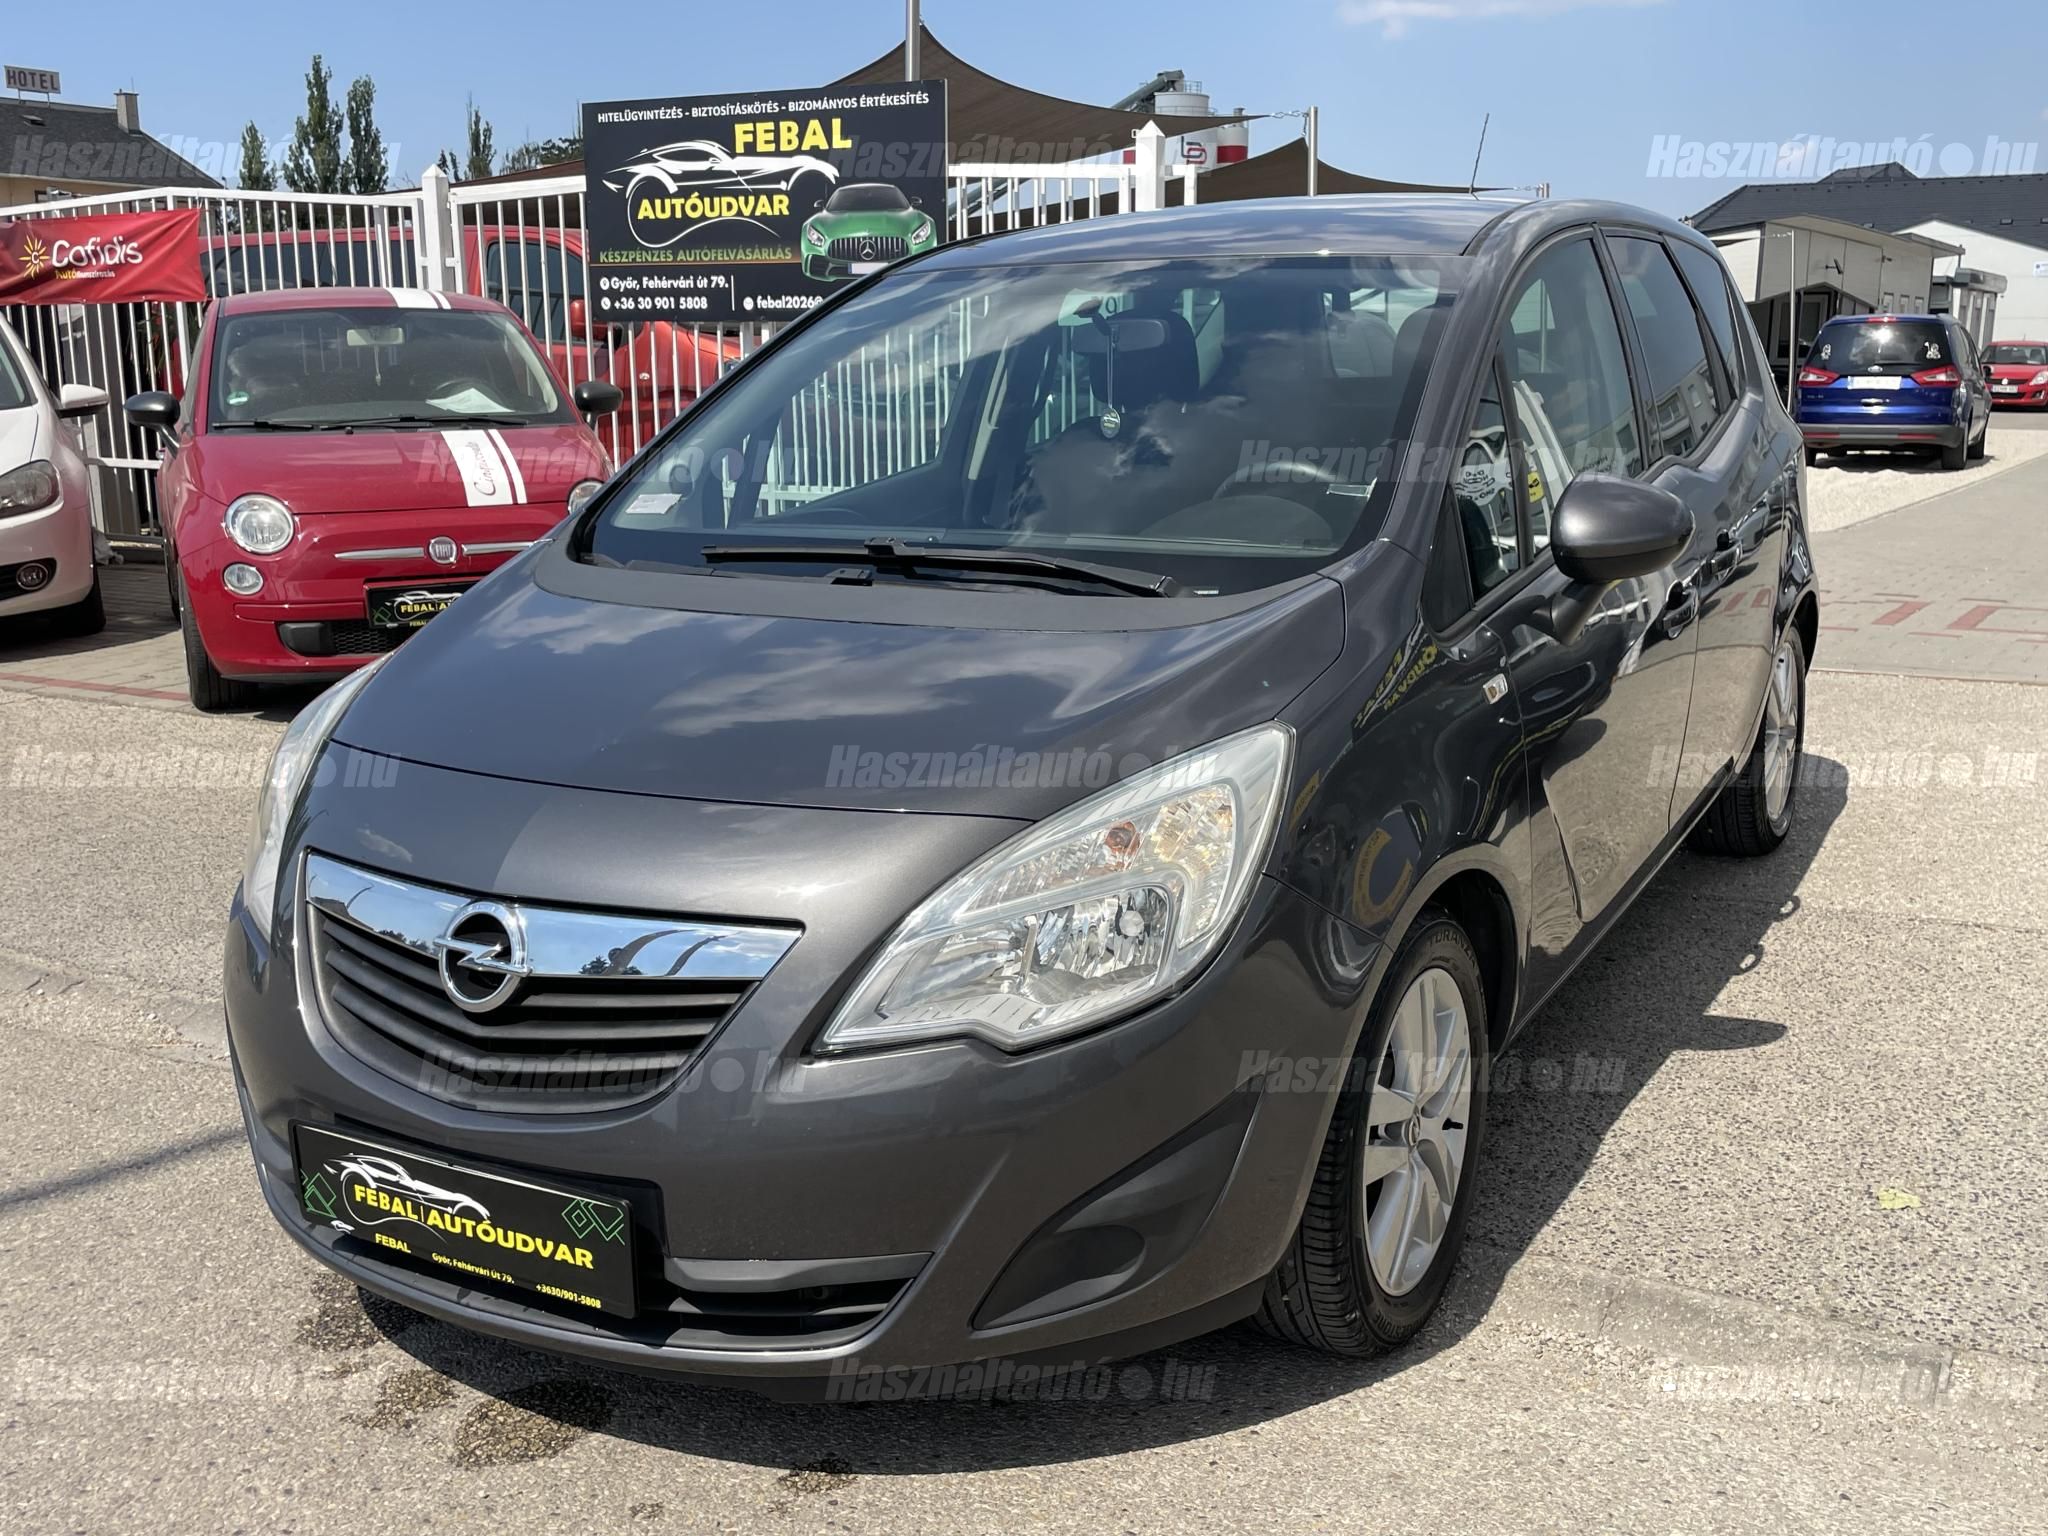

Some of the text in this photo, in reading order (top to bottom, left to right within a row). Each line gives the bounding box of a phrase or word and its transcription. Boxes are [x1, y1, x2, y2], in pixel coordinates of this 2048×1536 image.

[6, 69, 58, 91] HOTEL
[598, 91, 929, 123] HITELÜGYINTÉZÉS BIZTOSÍTÁSKÖTÉS BIZOMÁNYOS ÉRTÉKESÍTÉS
[735, 118, 852, 154] FEBAL
[637, 192, 790, 220] AUTÓUDVAR
[51, 236, 143, 268] Cofidis
[599, 244, 792, 263] KÉSZPÉNZES AUTÓFELVÁSÁRLÁS
[610, 275, 729, 292] Győr, Fehérvári út 79.
[614, 296, 708, 310] +36 30 901 5808
[400, 603, 435, 613] FEBAL
[353, 1184, 595, 1270] FEBAL AUTÓUDVAR
[375, 1233, 412, 1254] FEBAL
[453, 1258, 490, 1276] Fehérvári
[535, 1284, 601, 1309] +3630/901-5808
